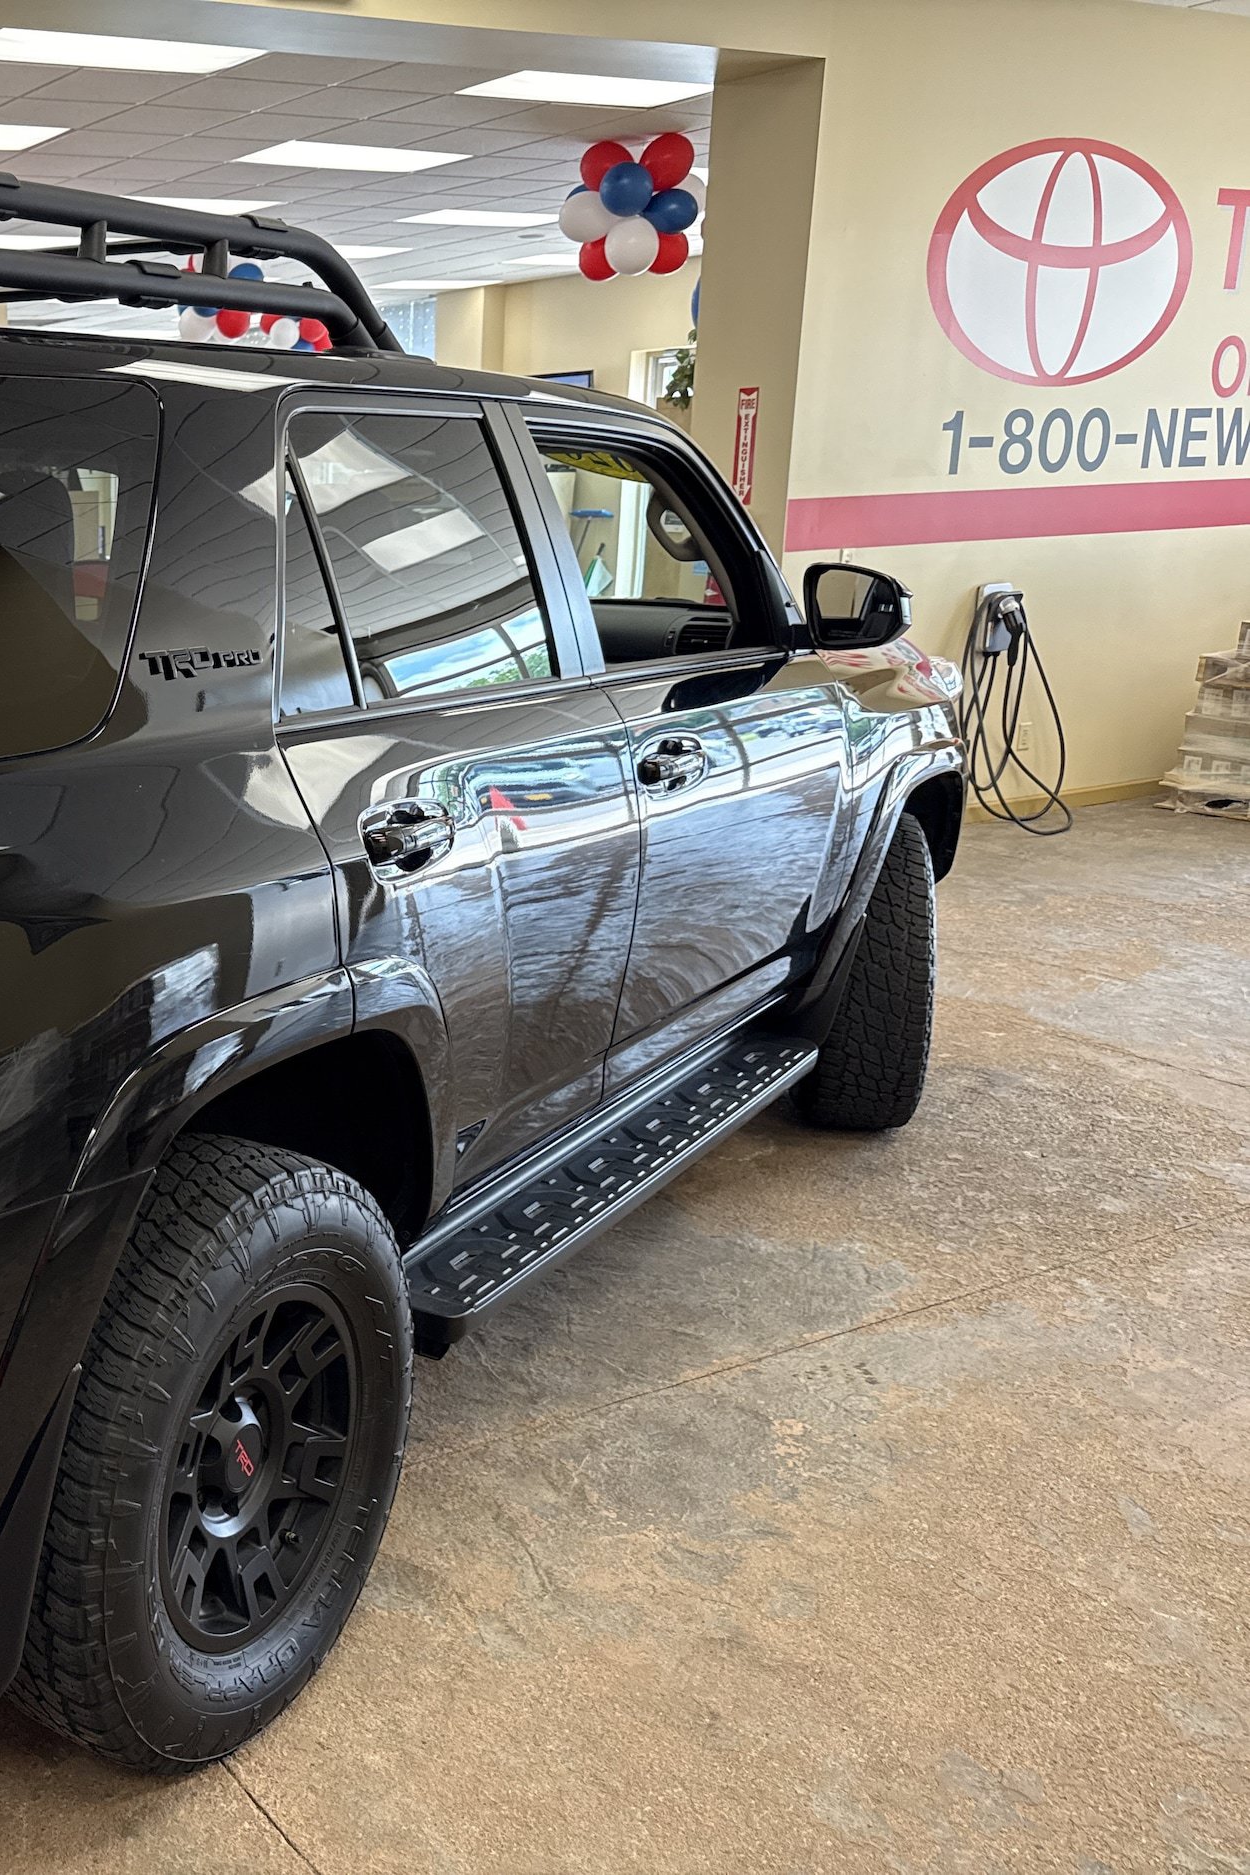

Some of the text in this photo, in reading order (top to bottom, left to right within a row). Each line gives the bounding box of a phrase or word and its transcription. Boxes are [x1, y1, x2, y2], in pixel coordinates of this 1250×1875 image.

[740, 398, 756, 410] FIRE
[738, 413, 751, 496] EXTINGUISHER
[138, 645, 264, 681] TRD PRO
[235, 1439, 254, 1477] TRD
